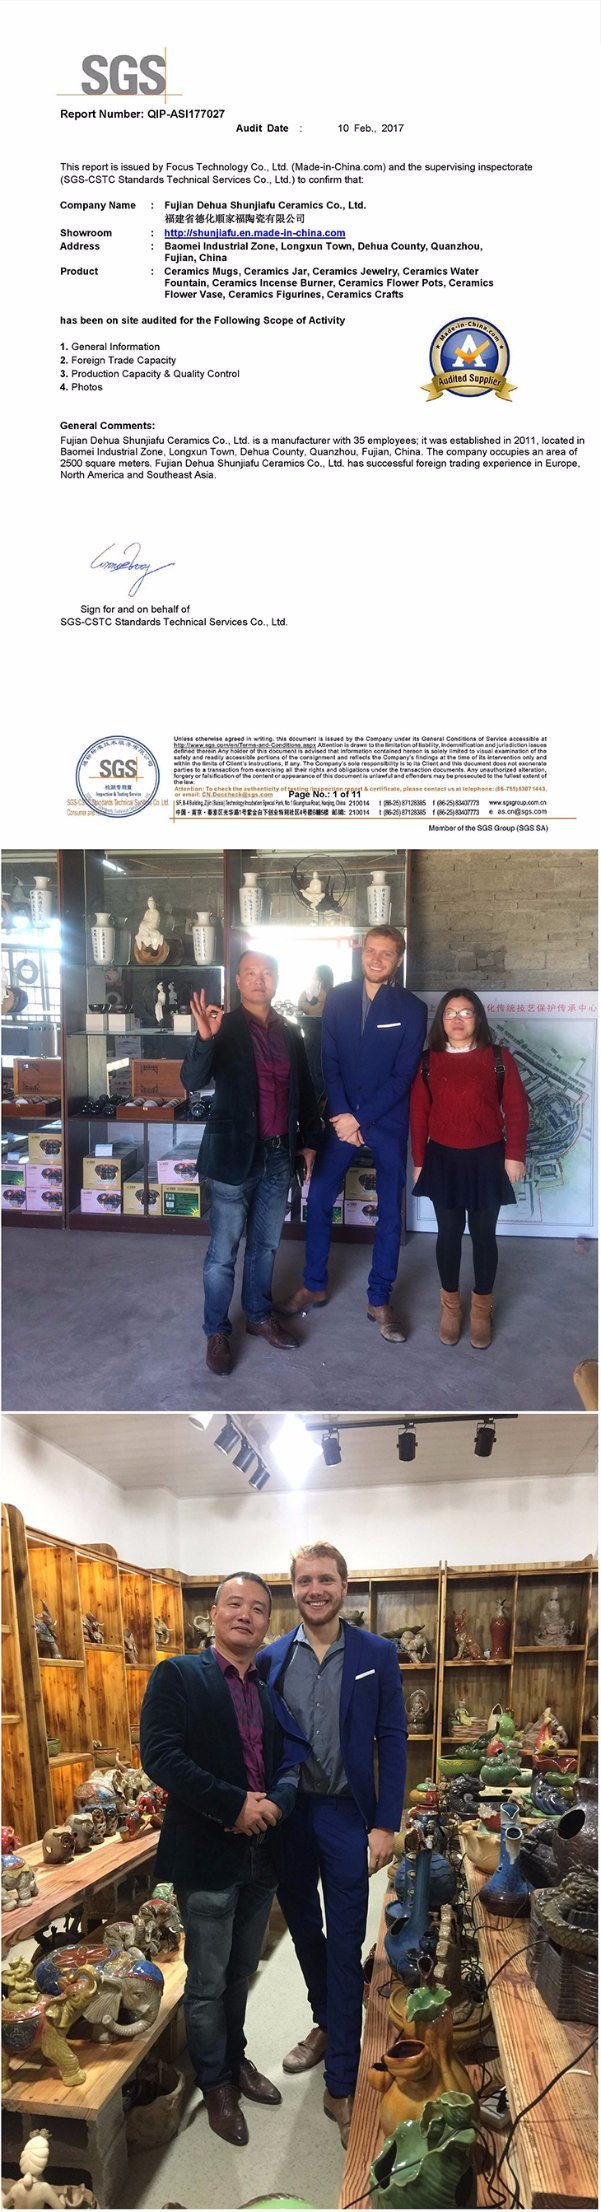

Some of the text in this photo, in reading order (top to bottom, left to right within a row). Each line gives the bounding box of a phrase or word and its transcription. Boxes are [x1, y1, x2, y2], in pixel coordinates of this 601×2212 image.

[81, 54, 166, 96] SGS
[61, 109, 225, 120] Report Number: QIP-ASI177027
[236, 124, 404, 133] Audit Date 10 Feb., 2017
[60, 163, 532, 173] This report is issued by Focus Technology Co., Ltd. (Made-in-China.com) and the supervising inspectorate
[61, 175, 115, 185] (SGS-CSTC
[118, 175, 164, 183] Standards
[167, 175, 209, 183] Technical
[213, 175, 251, 183] Services
[253, 175, 271, 184] Co.,
[275, 176, 295, 185] Ltd.)
[309, 175, 342, 183] confirm
[60, 201, 366, 211] Company Name Fujian Dehua Shunjiafu Ceramics Co., Ltd.
[165, 213, 304, 224] 福建省德化顺家福陶瓷有限公司
[60, 229, 346, 239] Showroom http://shunjiafu.en.made-in-china.com
[60, 242, 483, 252] Address Baomei Industrial Zone, Longxun Town, Dehua County, Quanzhou,
[165, 254, 196, 264] Fujian,
[61, 267, 479, 277] Product Ceramics Mugs, Ceramics Jar, Ceramics Jewelry, Ceramics Water
[165, 279, 493, 288] Fountain, Ceramics Incense Burner, Ceramics Flower Pots, Ceramics
[165, 290, 403, 300] Flower Vase, Ceramics Figurines, Ceramics Crafts
[60, 316, 77, 324] has
[80, 316, 103, 324] been
[122, 316, 138, 324] site
[142, 316, 176, 324] audited
[180, 316, 194, 324] for
[196, 316, 211, 324] the
[214, 316, 260, 326] Following
[263, 316, 293, 326] Scope
[296, 316, 306, 324] of
[309, 316, 345, 326] Activity
[439, 321, 499, 342] Made-in-China.com
[72, 342, 107, 350] General
[110, 342, 160, 350] Information
[60, 356, 176, 366] 2. Foreign Trade Capacity
[122, 370, 161, 380] Capacity
[174, 370, 204, 379] Quality
[438, 374, 501, 387] Audited Supplier
[60, 383, 103, 391] 4. Photos
[60, 421, 97, 429] General
[81, 605, 100, 615] Sign
[103, 605, 115, 613] for
[118, 605, 134, 613] and
[151, 605, 179, 613] behalf
[181, 605, 190, 613] of
[99, 759, 137, 778] SGS
[289, 791, 310, 799] Page
[489, 800, 547, 808] www.sgsgroup.com.cn
[494, 825, 515, 834] Group
[516, 825, 534, 834] (SGS
[536, 825, 548, 834] SA)
